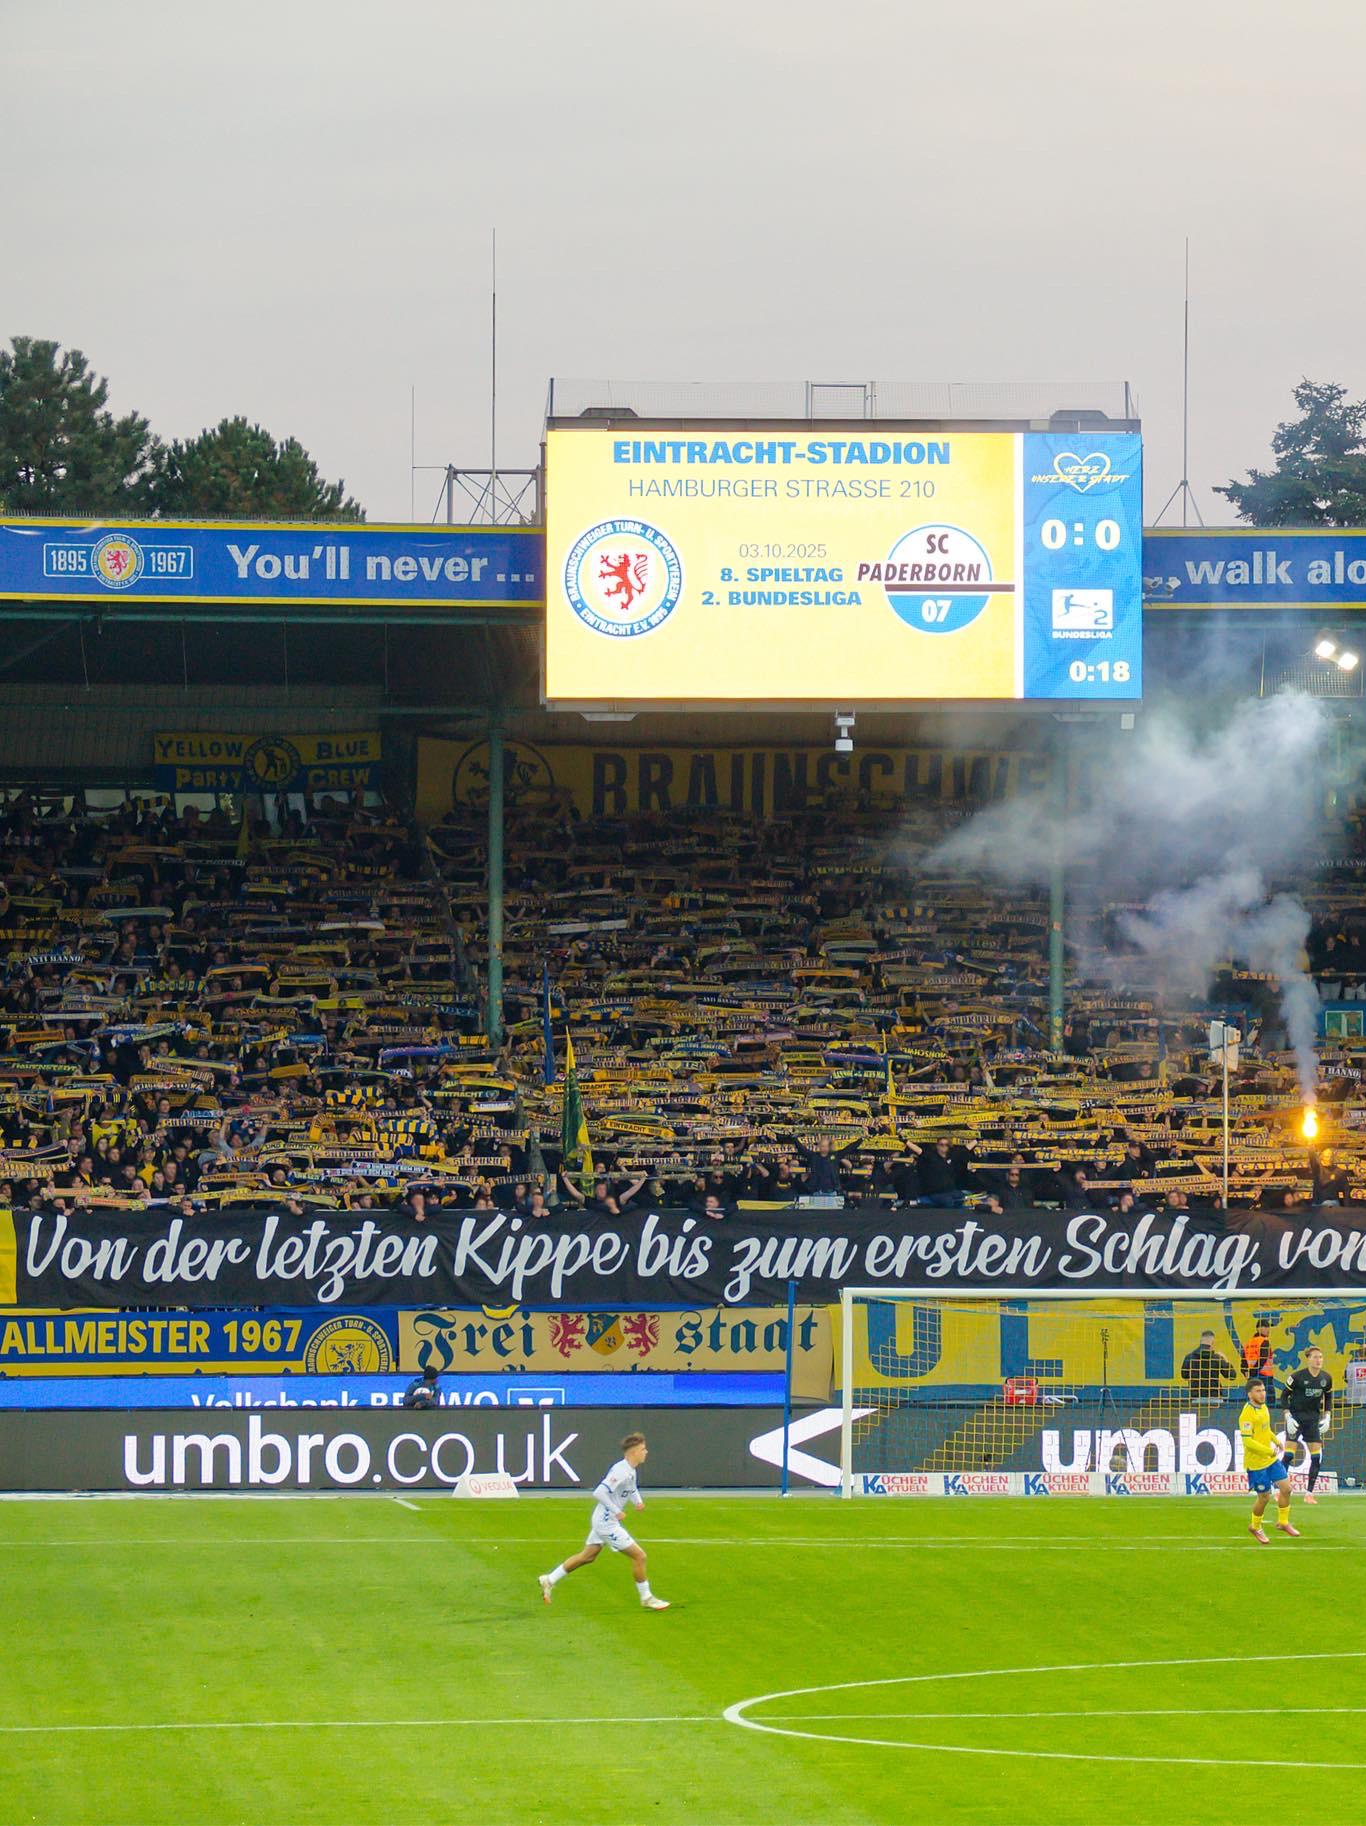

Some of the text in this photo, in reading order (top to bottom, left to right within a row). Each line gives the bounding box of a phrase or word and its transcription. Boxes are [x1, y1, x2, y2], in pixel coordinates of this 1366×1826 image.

[613, 441, 950, 465] EINTRACHT-STADION
[629, 479, 935, 498] HAMBURGER STRASSE 210
[739, 543, 827, 559] 03.10.2025
[926, 532, 949, 554] SC
[50, 550, 87, 572] 1895
[149, 551, 187, 574] 1967
[1184, 551, 1294, 585] walk
[721, 567, 843, 583] 8. SPIELTAG
[857, 562, 981, 583] PADERBORN
[702, 591, 862, 607] 2. BUNDESLIGA
[920, 599, 952, 624] 07
[1052, 630, 1113, 639] BUNDESLIGA
[1069, 660, 1131, 683] 0:18
[157, 740, 370, 760] YELLOW BLUE
[26, 1215, 137, 1281] Von
[143, 1218, 251, 1283] der
[255, 1215, 439, 1303] letzten
[454, 1213, 630, 1301] Kippe
[637, 1214, 713, 1278] bis
[724, 1236, 857, 1303] zum
[865, 1221, 1052, 1279] ersten
[1058, 1214, 1261, 1299] Schlag,
[0, 1319, 303, 1355] ALLMEISTER 1967
[413, 1311, 537, 1372] Frei
[370, 1392, 498, 1406] BRWO
[124, 1412, 581, 1485] umbro.couk
